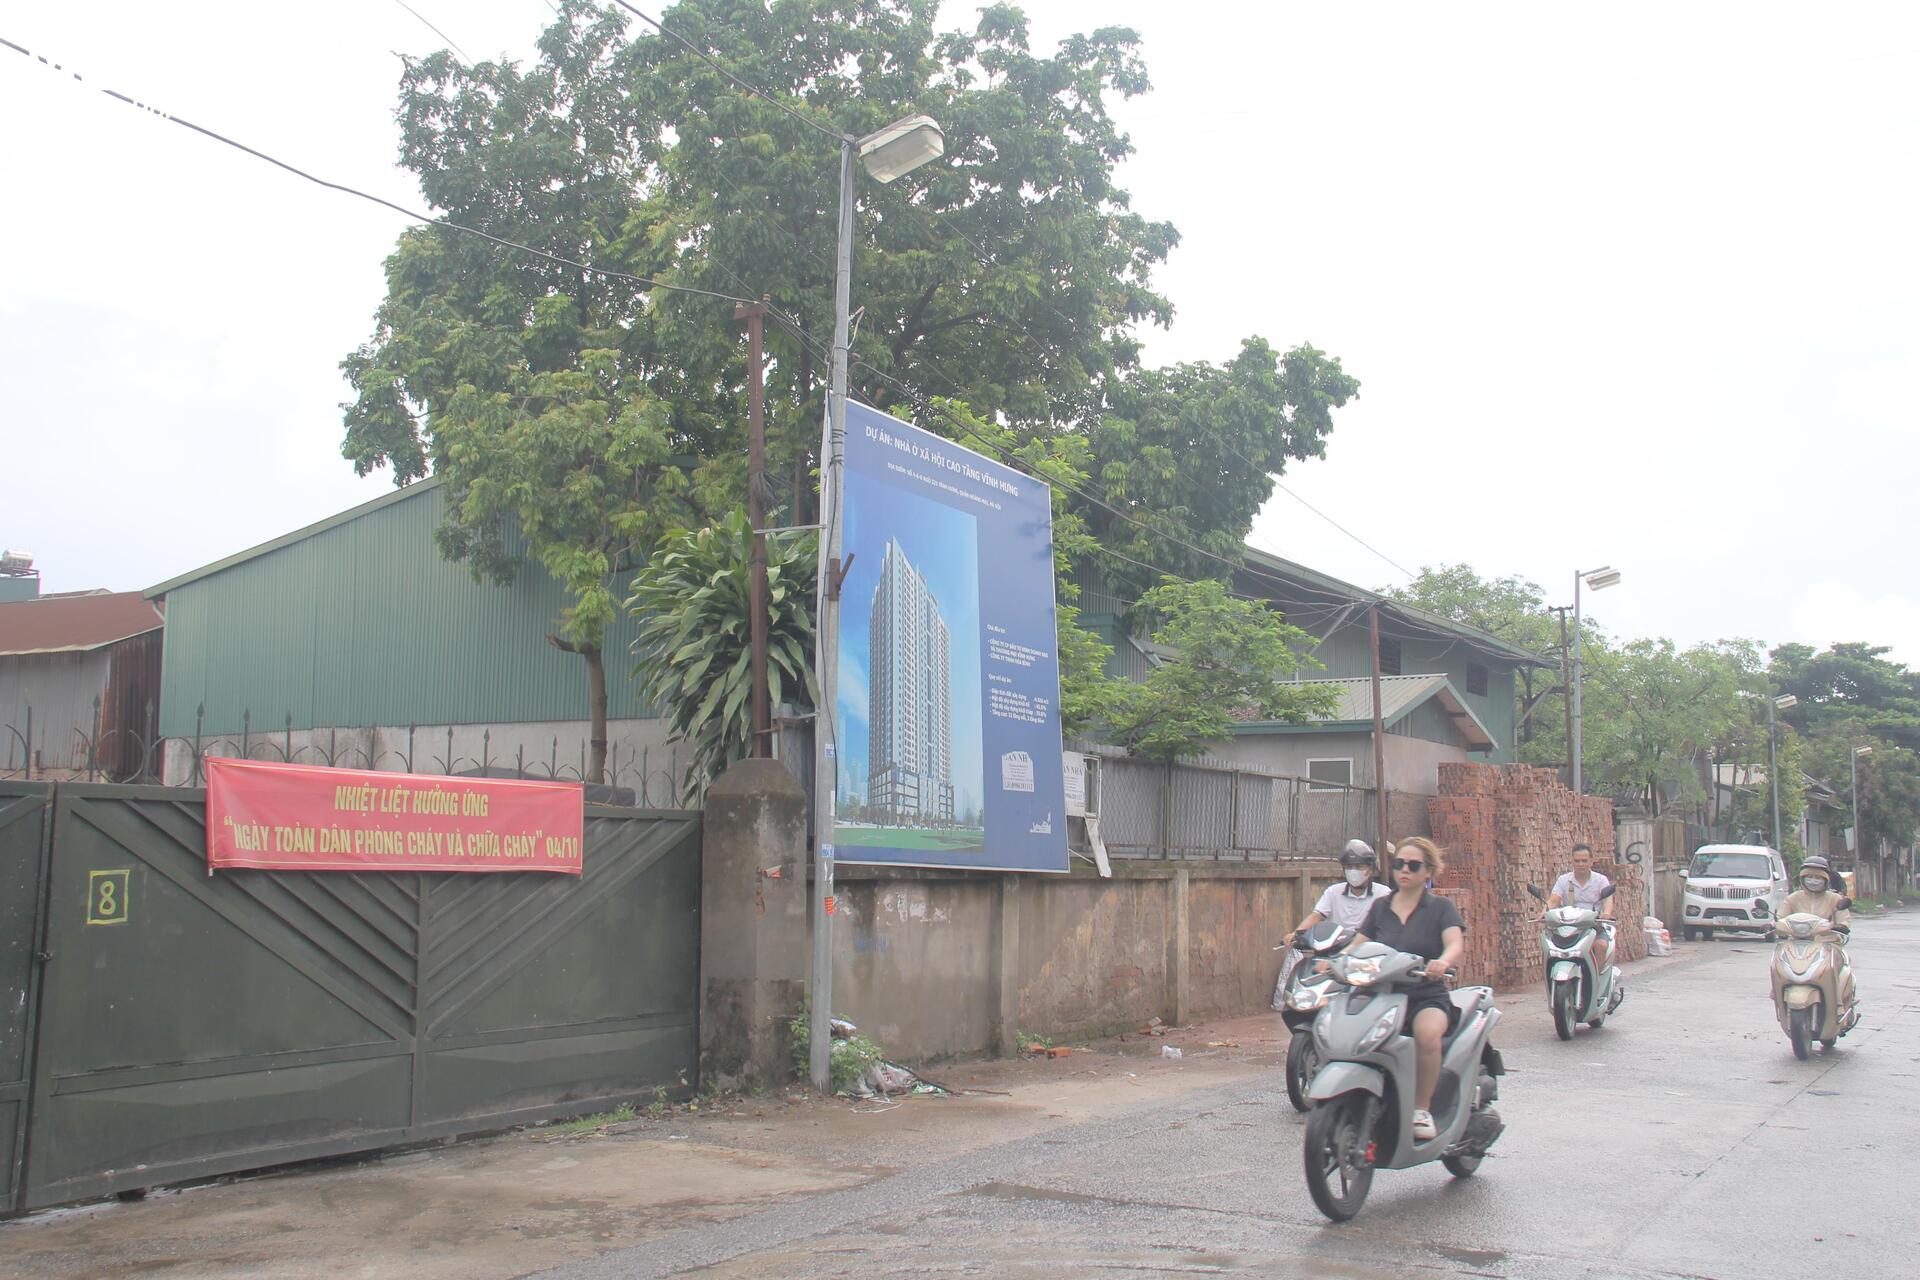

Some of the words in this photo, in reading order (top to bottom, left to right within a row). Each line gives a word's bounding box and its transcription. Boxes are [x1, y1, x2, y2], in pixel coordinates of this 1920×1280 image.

[865, 425, 878, 442] DỰ
[879, 428, 893, 446] ÁN:
[894, 438, 911, 454] NHÀ
[912, 442, 919, 456] Ở
[919, 447, 930, 461] XÃ
[931, 452, 945, 468] HỘI
[946, 459, 961, 473] CAO
[961, 463, 981, 481] TẦNG
[981, 472, 999, 489] VĨNH
[999, 480, 1019, 497] HƯNG
[334, 781, 379, 817] NHIỆT
[380, 784, 411, 819] LIỆT
[412, 783, 458, 817] HƯỞNG
[462, 788, 489, 817] ỨNG
[274, 821, 315, 853] TOÀN
[319, 823, 351, 854] DÂN
[354, 824, 404, 855] PHÒNG
[407, 827, 443, 856] CHÁY
[446, 828, 464, 857] VÀ
[467, 829, 500, 857] CHỮA
[546, 836, 578, 859] 04/10
[98, 880, 117, 915] 8
